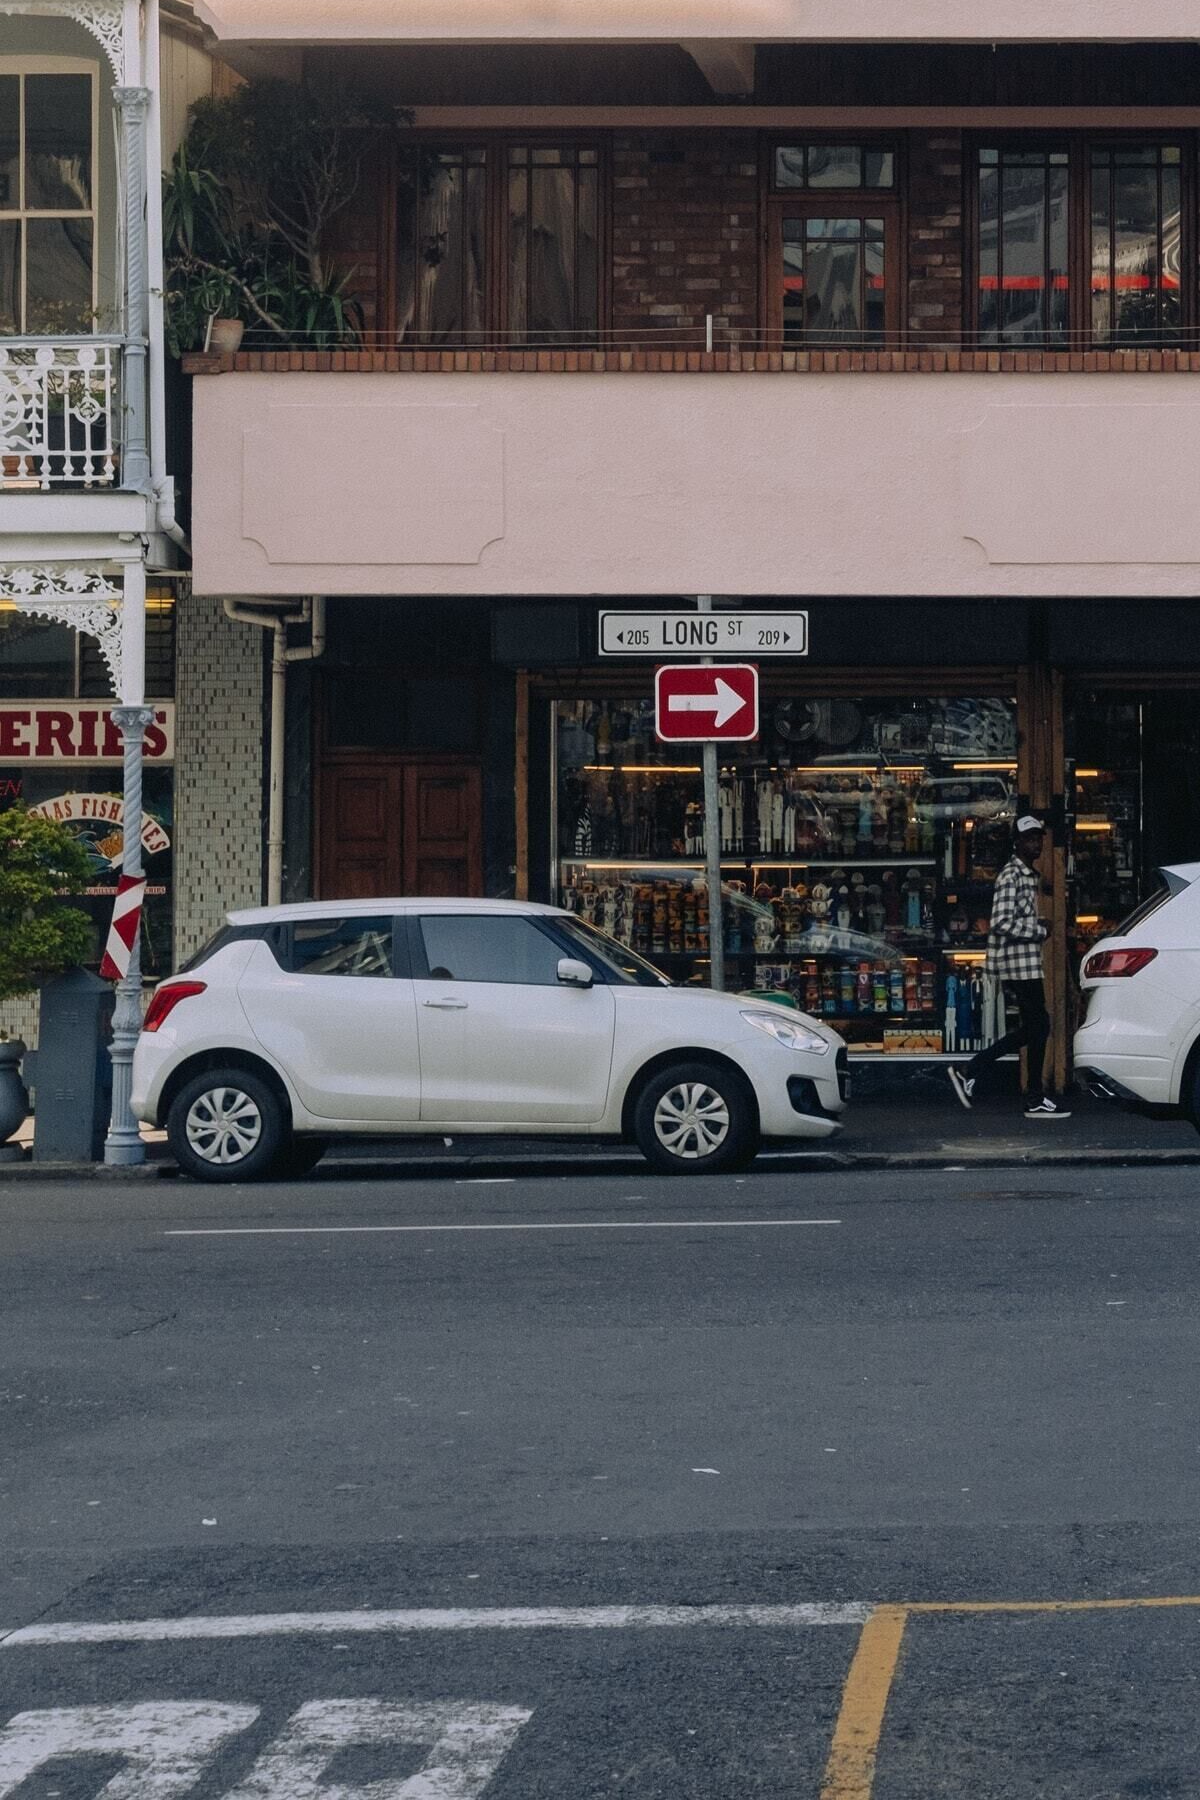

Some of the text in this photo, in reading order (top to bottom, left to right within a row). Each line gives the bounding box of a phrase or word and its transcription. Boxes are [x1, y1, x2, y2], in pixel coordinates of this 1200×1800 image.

[626, 620, 781, 646] 205 LONG ST 209
[81, 798, 168, 852] FISHIES
